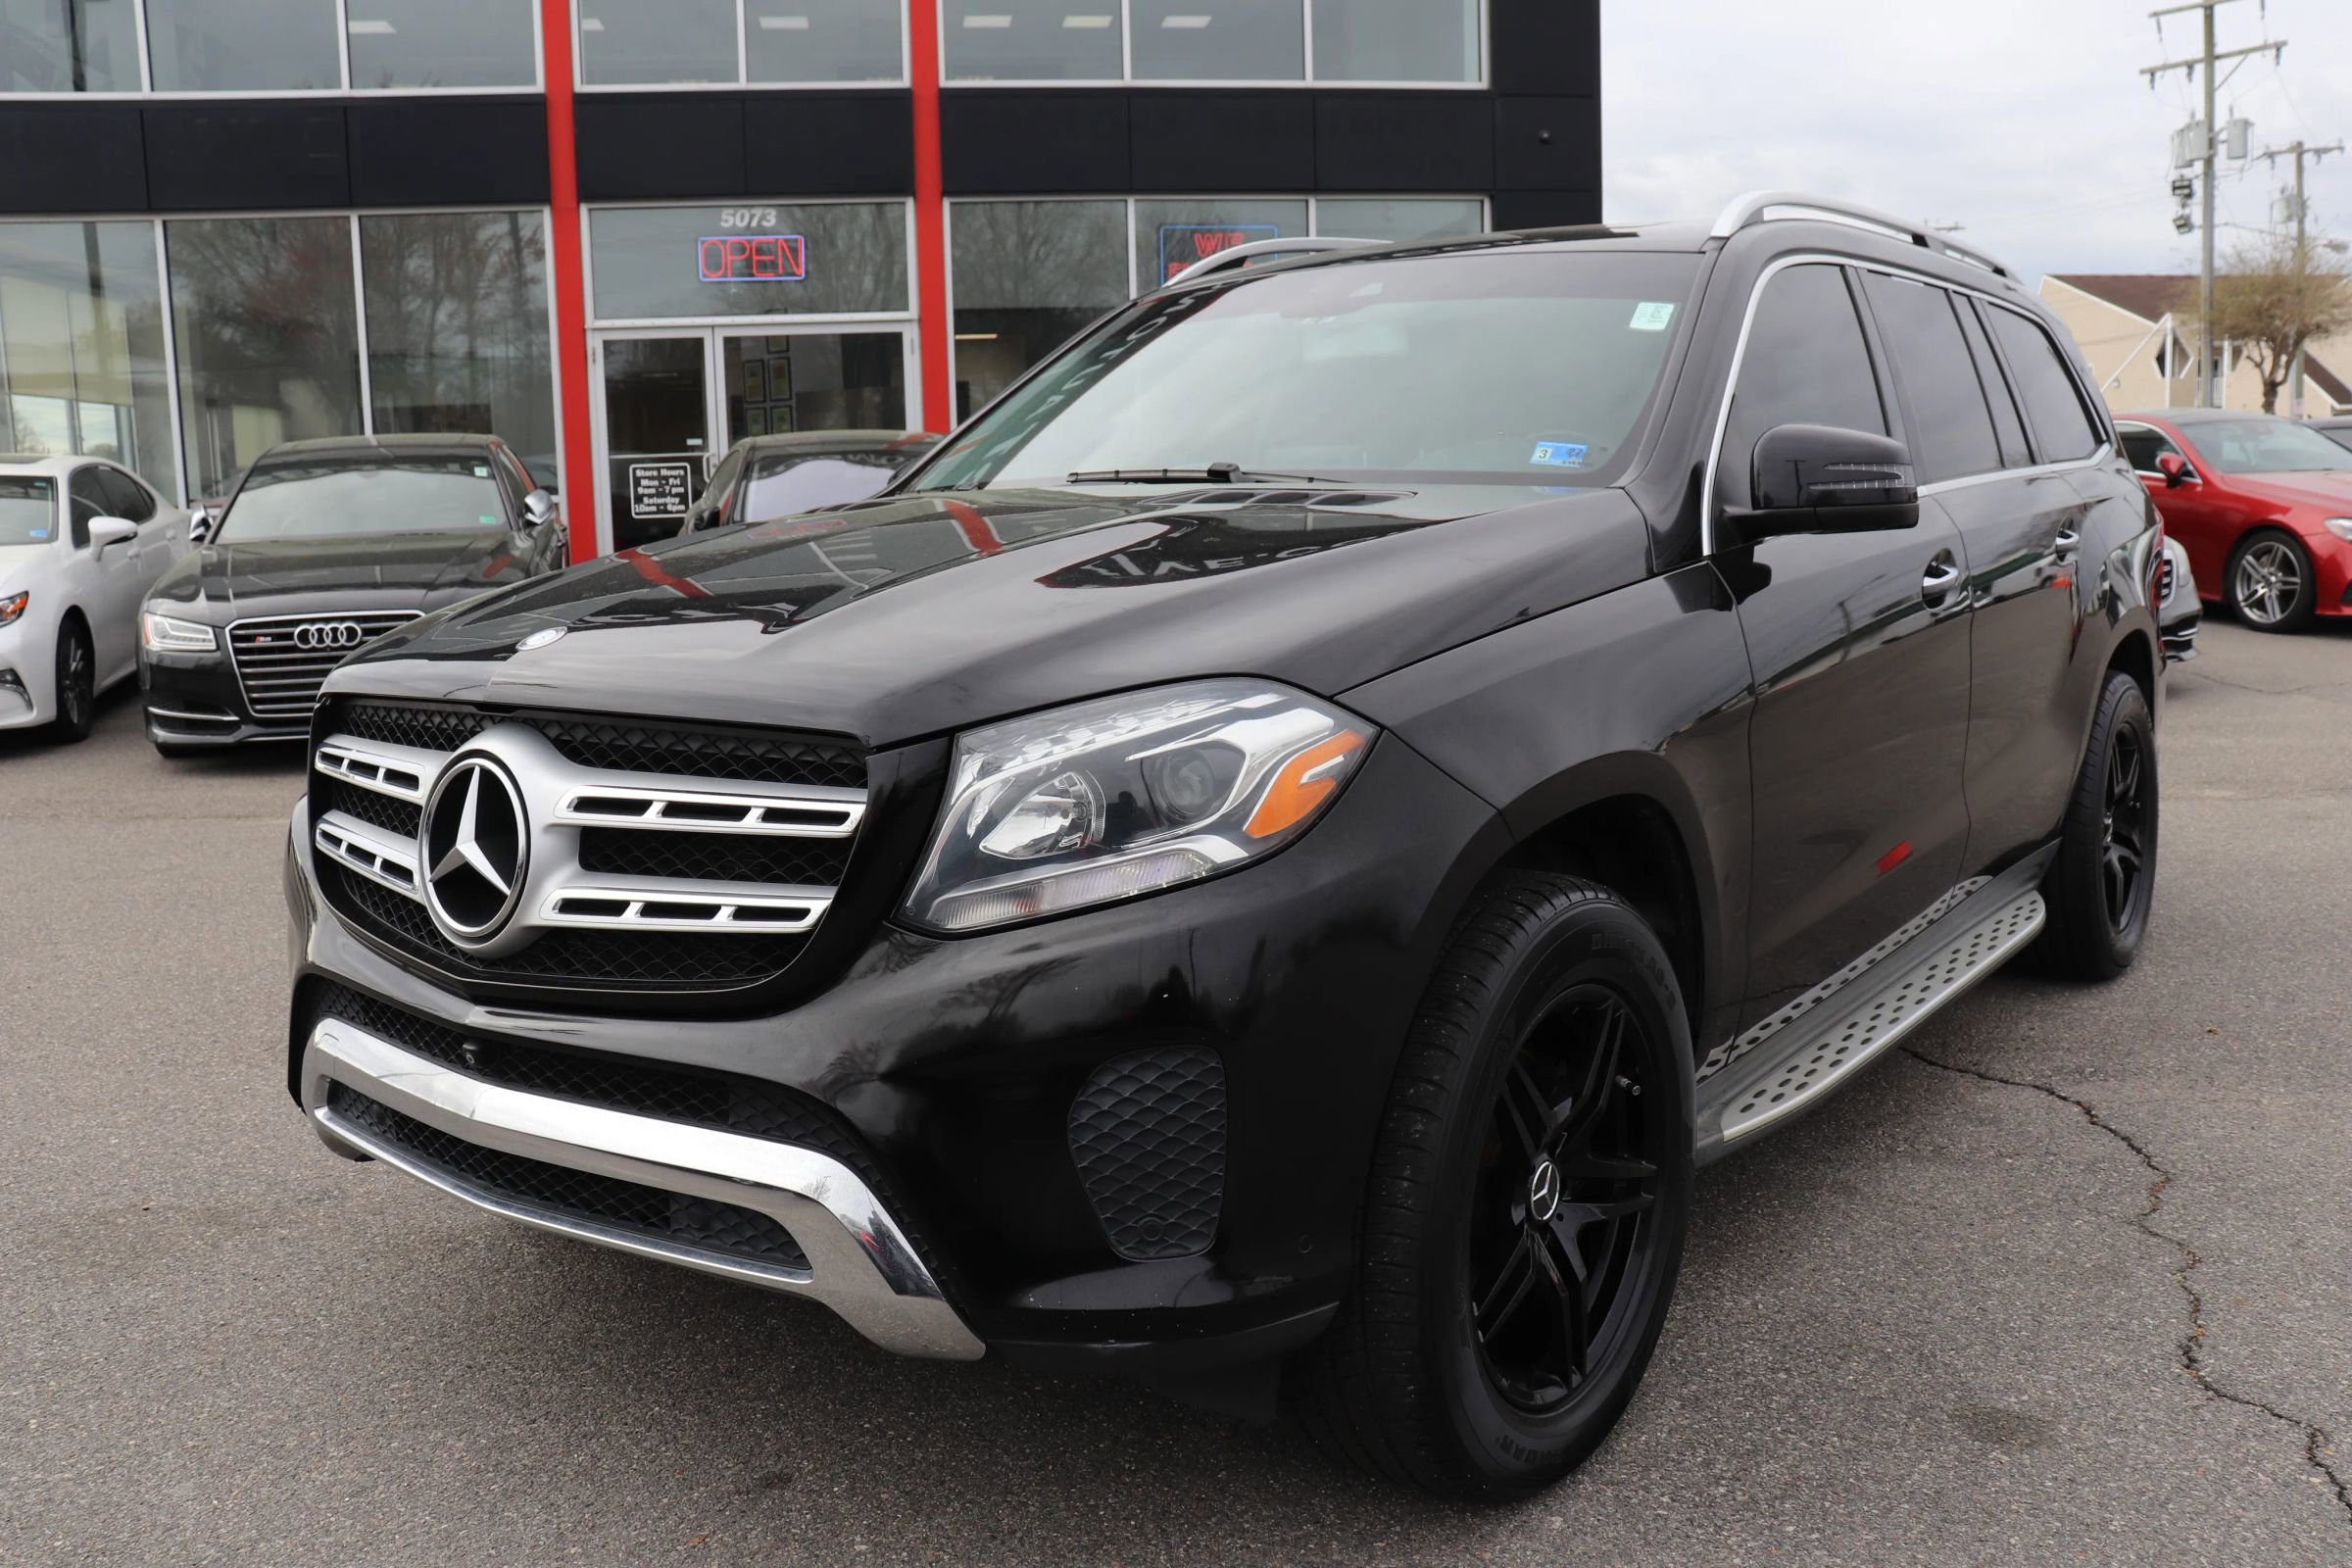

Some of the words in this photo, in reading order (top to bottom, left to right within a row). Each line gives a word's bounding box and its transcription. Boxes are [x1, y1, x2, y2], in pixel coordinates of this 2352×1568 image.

[720, 209, 777, 228] 5073
[702, 235, 803, 278] OPEN
[1539, 449, 1548, 459] 3
[636, 468, 659, 477] Store
[661, 467, 684, 476] Hours
[668, 477, 680, 486] Fri
[637, 486, 656, 495] 9am
[643, 496, 680, 505] Saturday
[635, 504, 657, 513] 10am
[666, 504, 685, 513] 6pm
